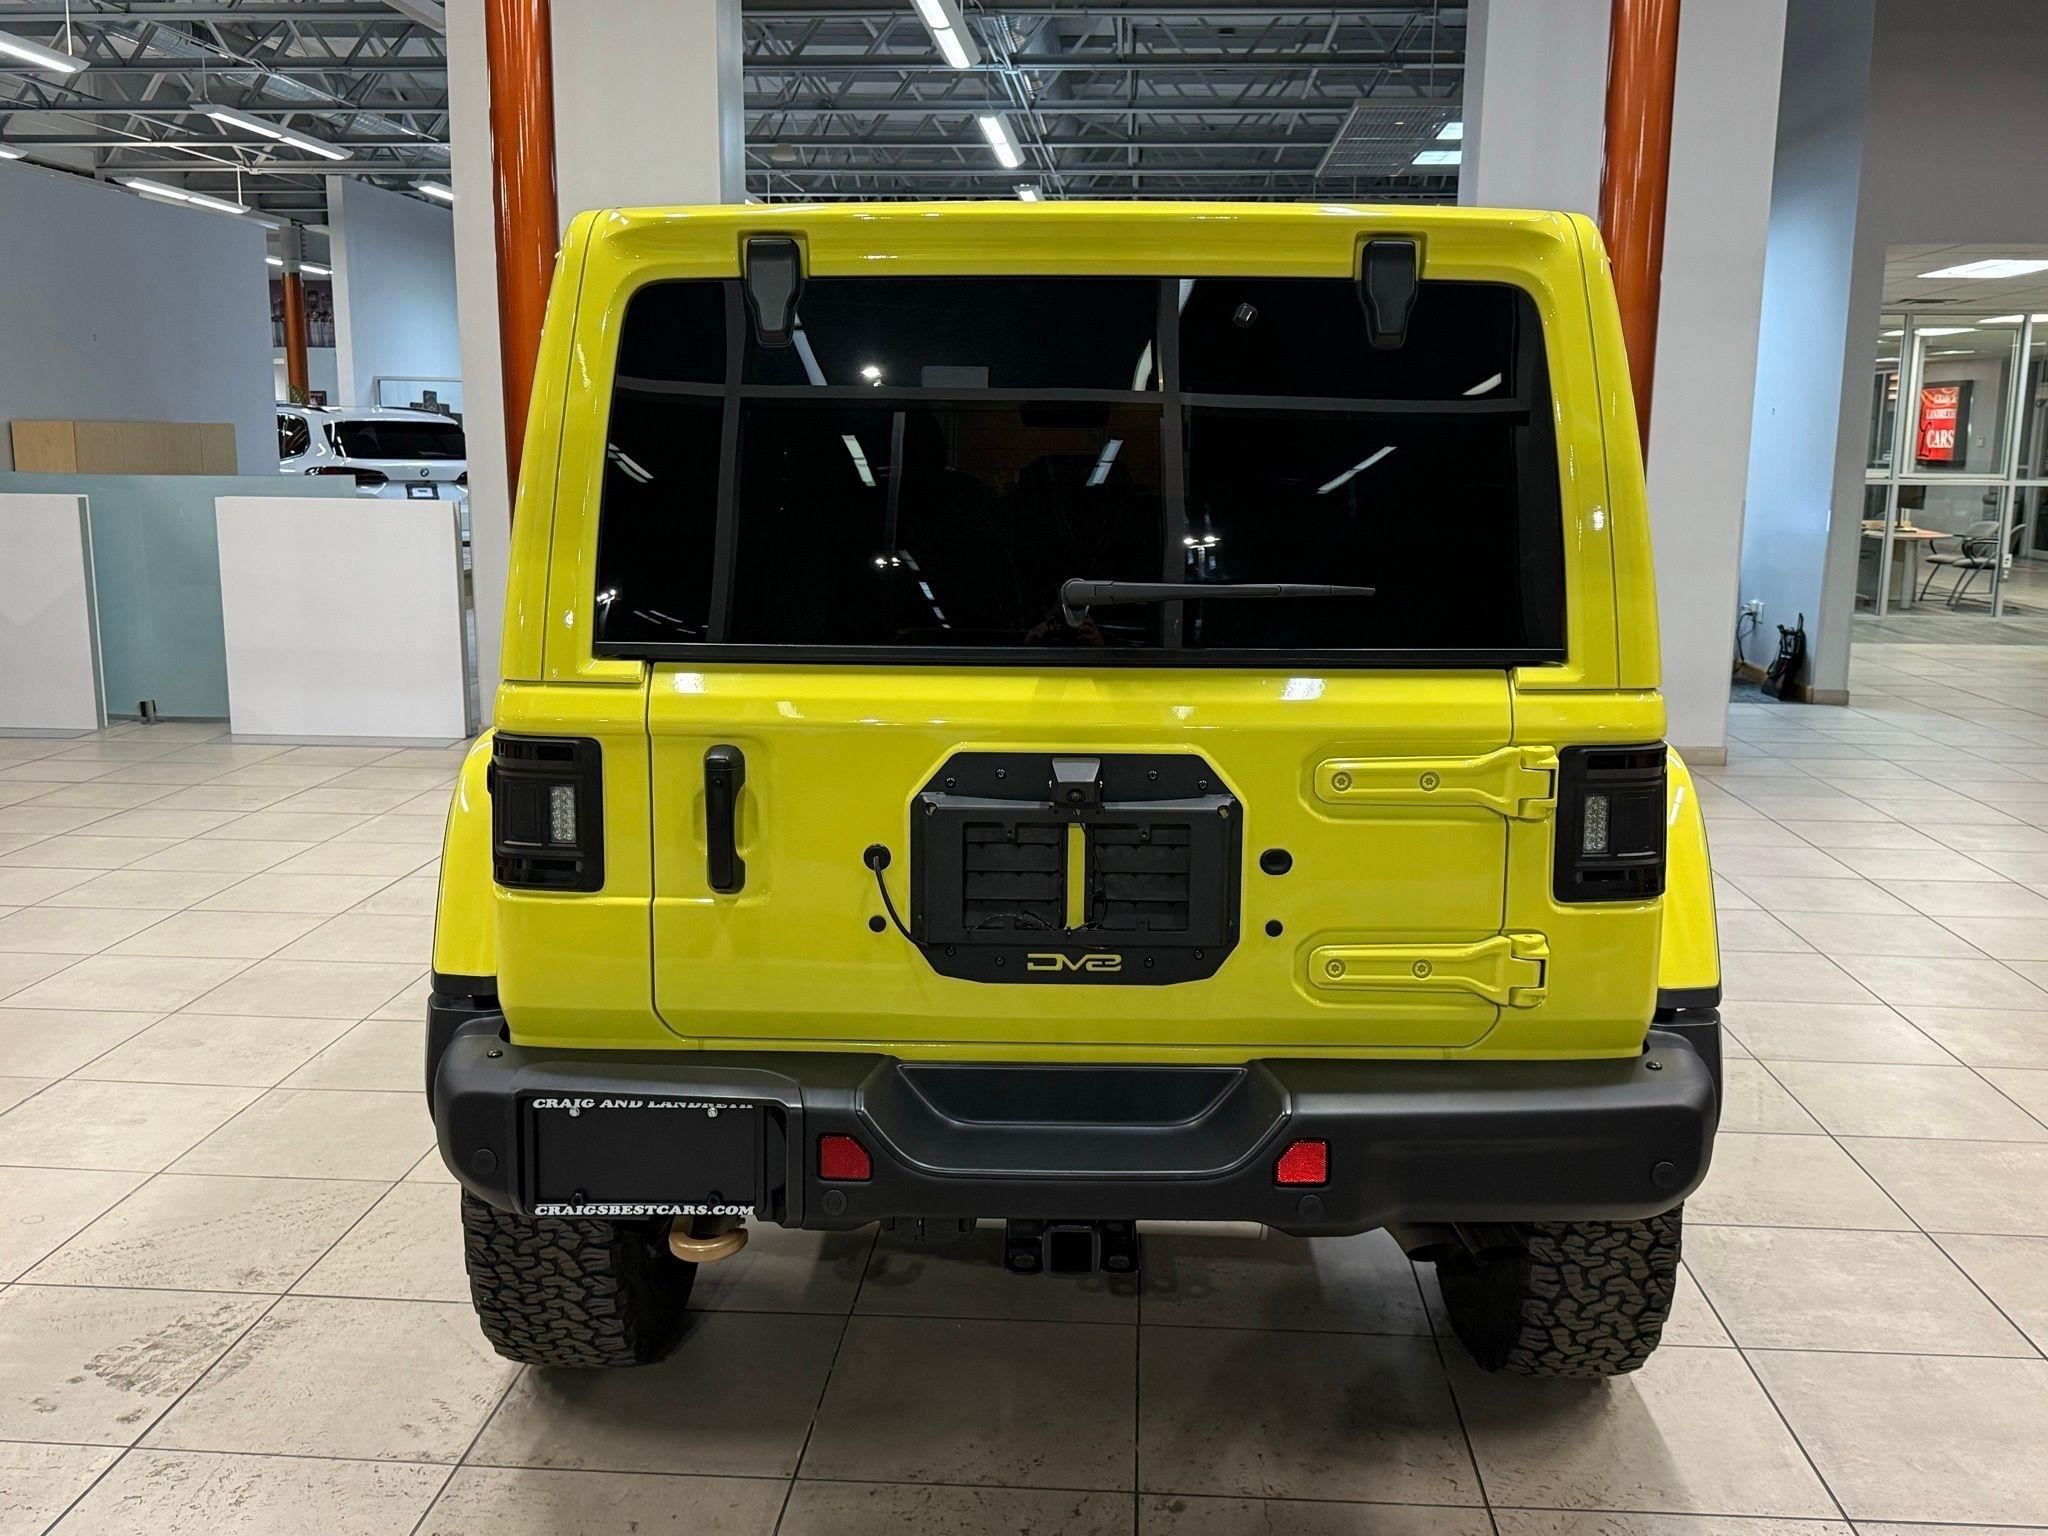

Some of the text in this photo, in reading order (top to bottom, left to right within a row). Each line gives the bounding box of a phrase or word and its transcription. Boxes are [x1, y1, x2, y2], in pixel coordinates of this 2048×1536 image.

[1926, 429, 1954, 448] CARS
[532, 1098, 596, 1109] CRAIG
[599, 1099, 644, 1109] AND
[534, 1205, 755, 1216] CRAIGSBESTCARS.COM
